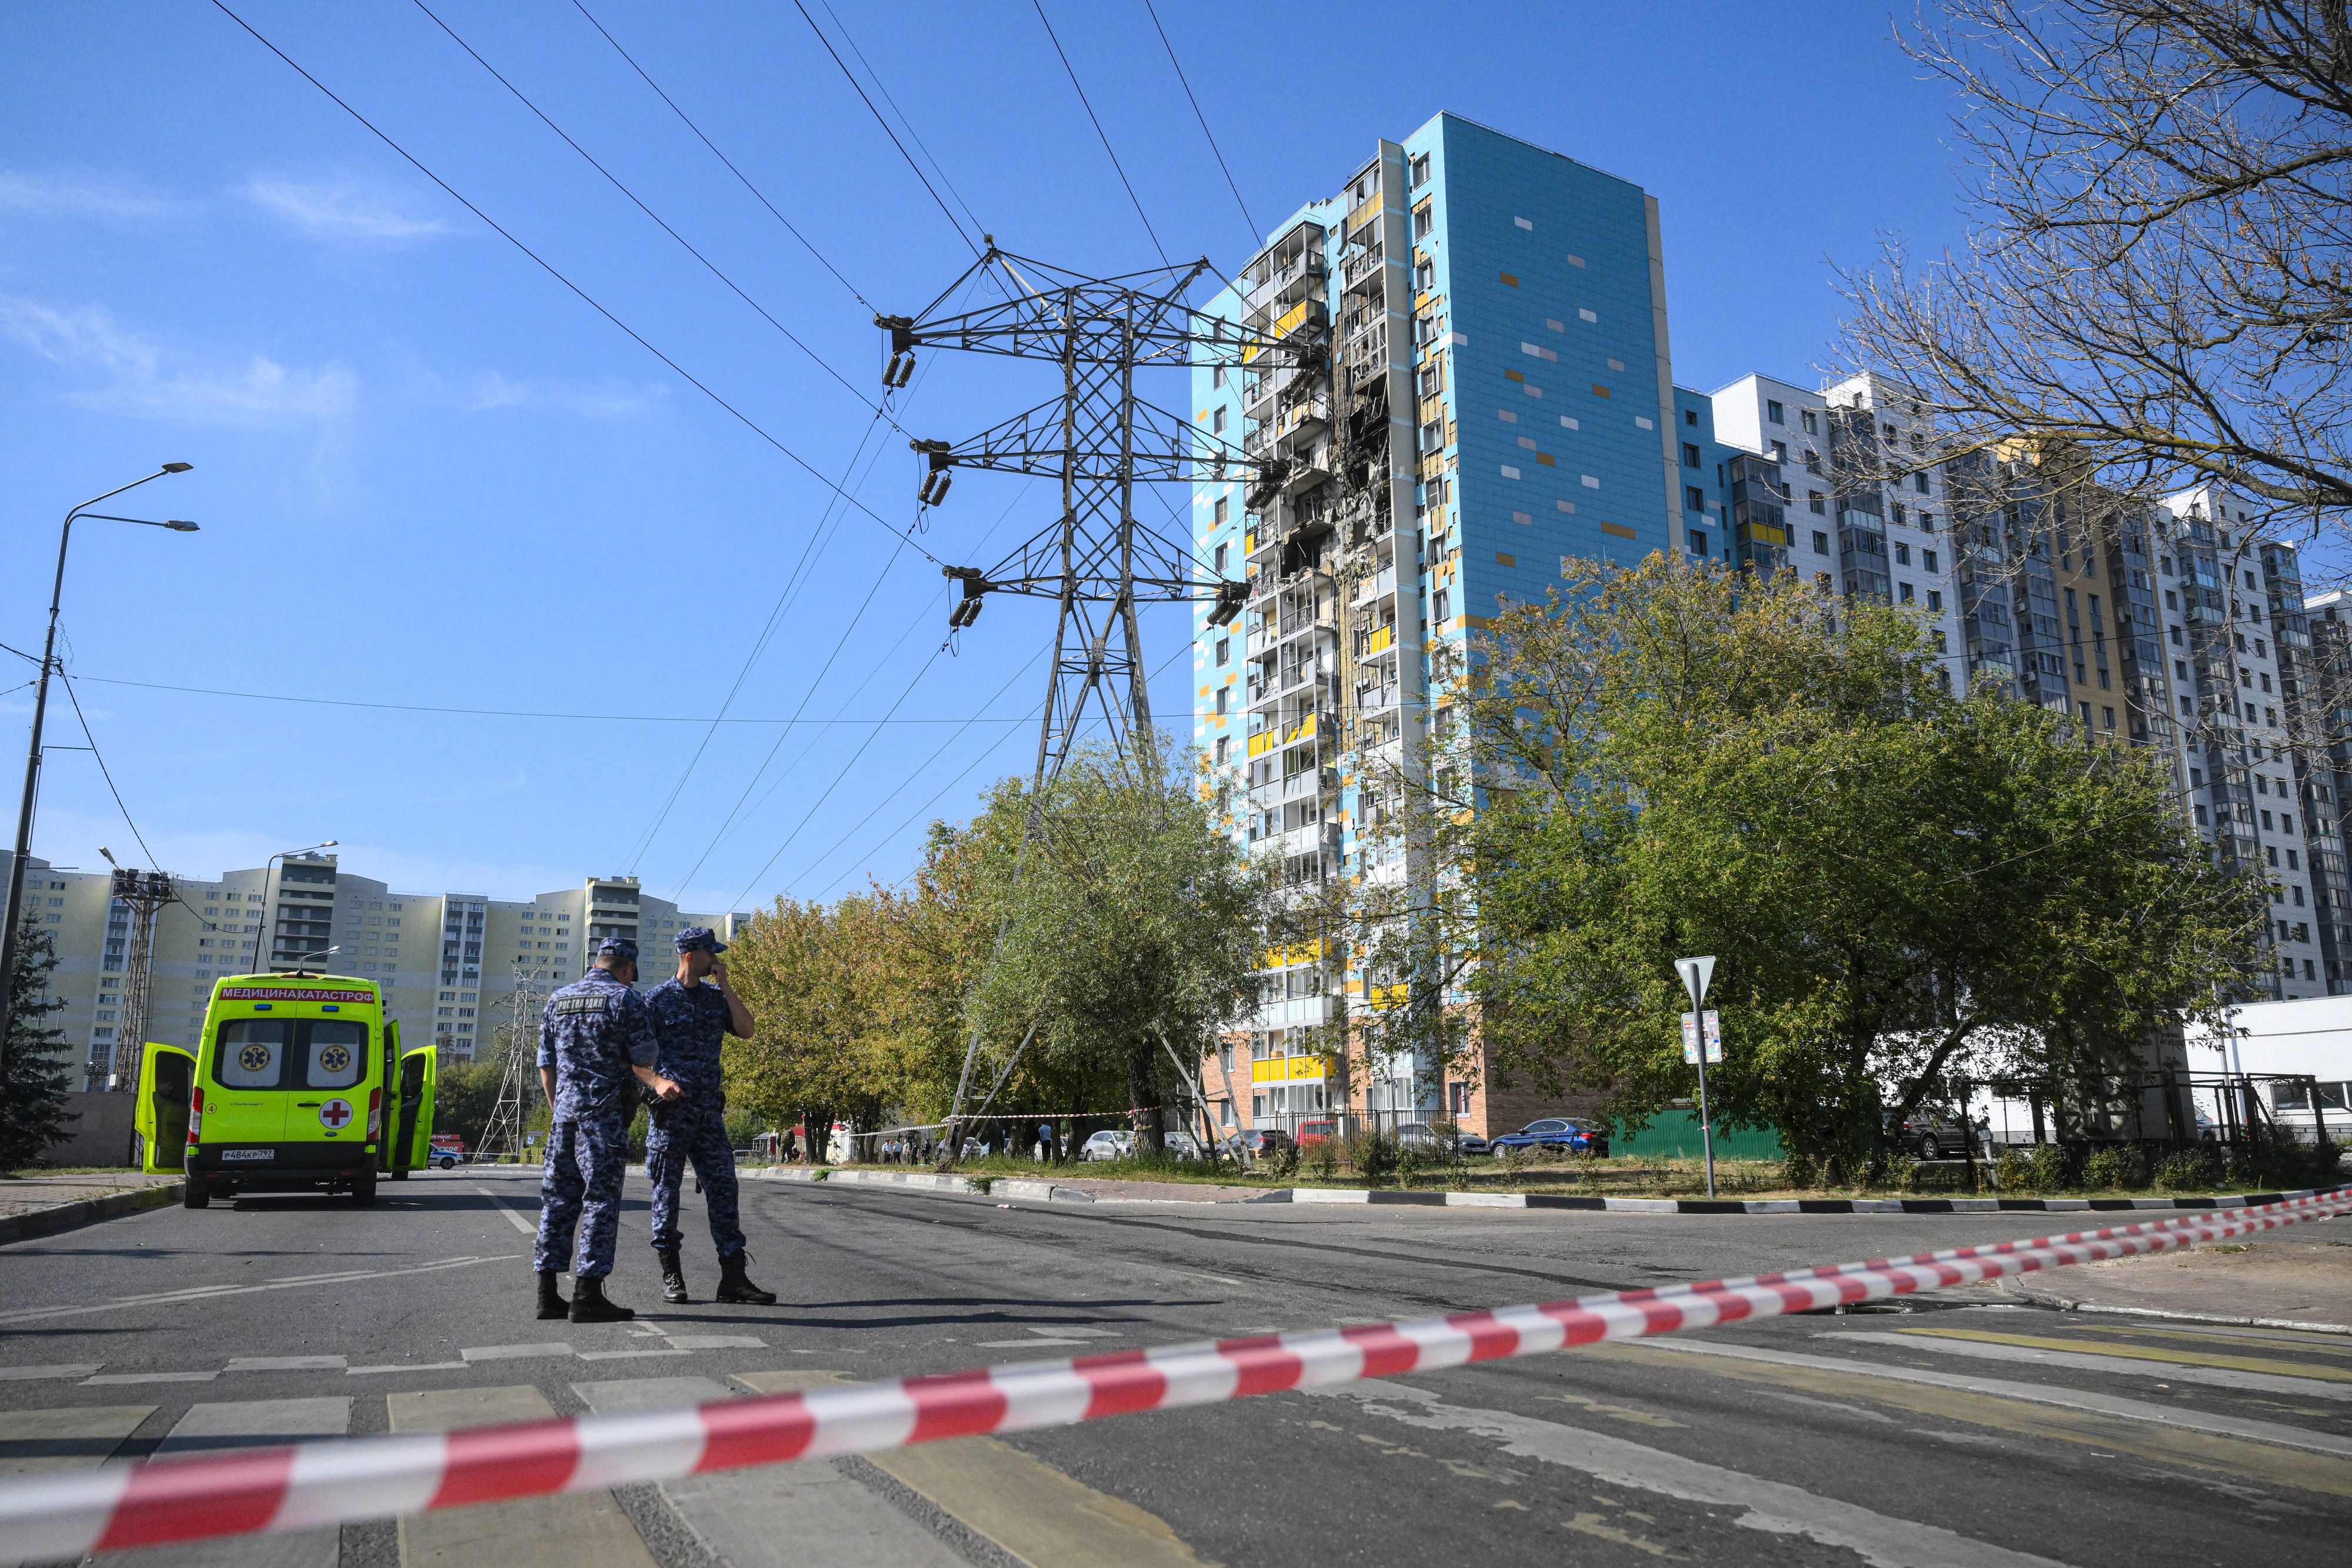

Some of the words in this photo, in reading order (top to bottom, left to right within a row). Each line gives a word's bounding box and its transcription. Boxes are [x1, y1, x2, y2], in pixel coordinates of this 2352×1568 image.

[222, 988, 296, 999] МЕДИЦИНА
[298, 989, 373, 1002] КАТАСТРОФ
[558, 998, 603, 1010] РОСГВАРДИЯ
